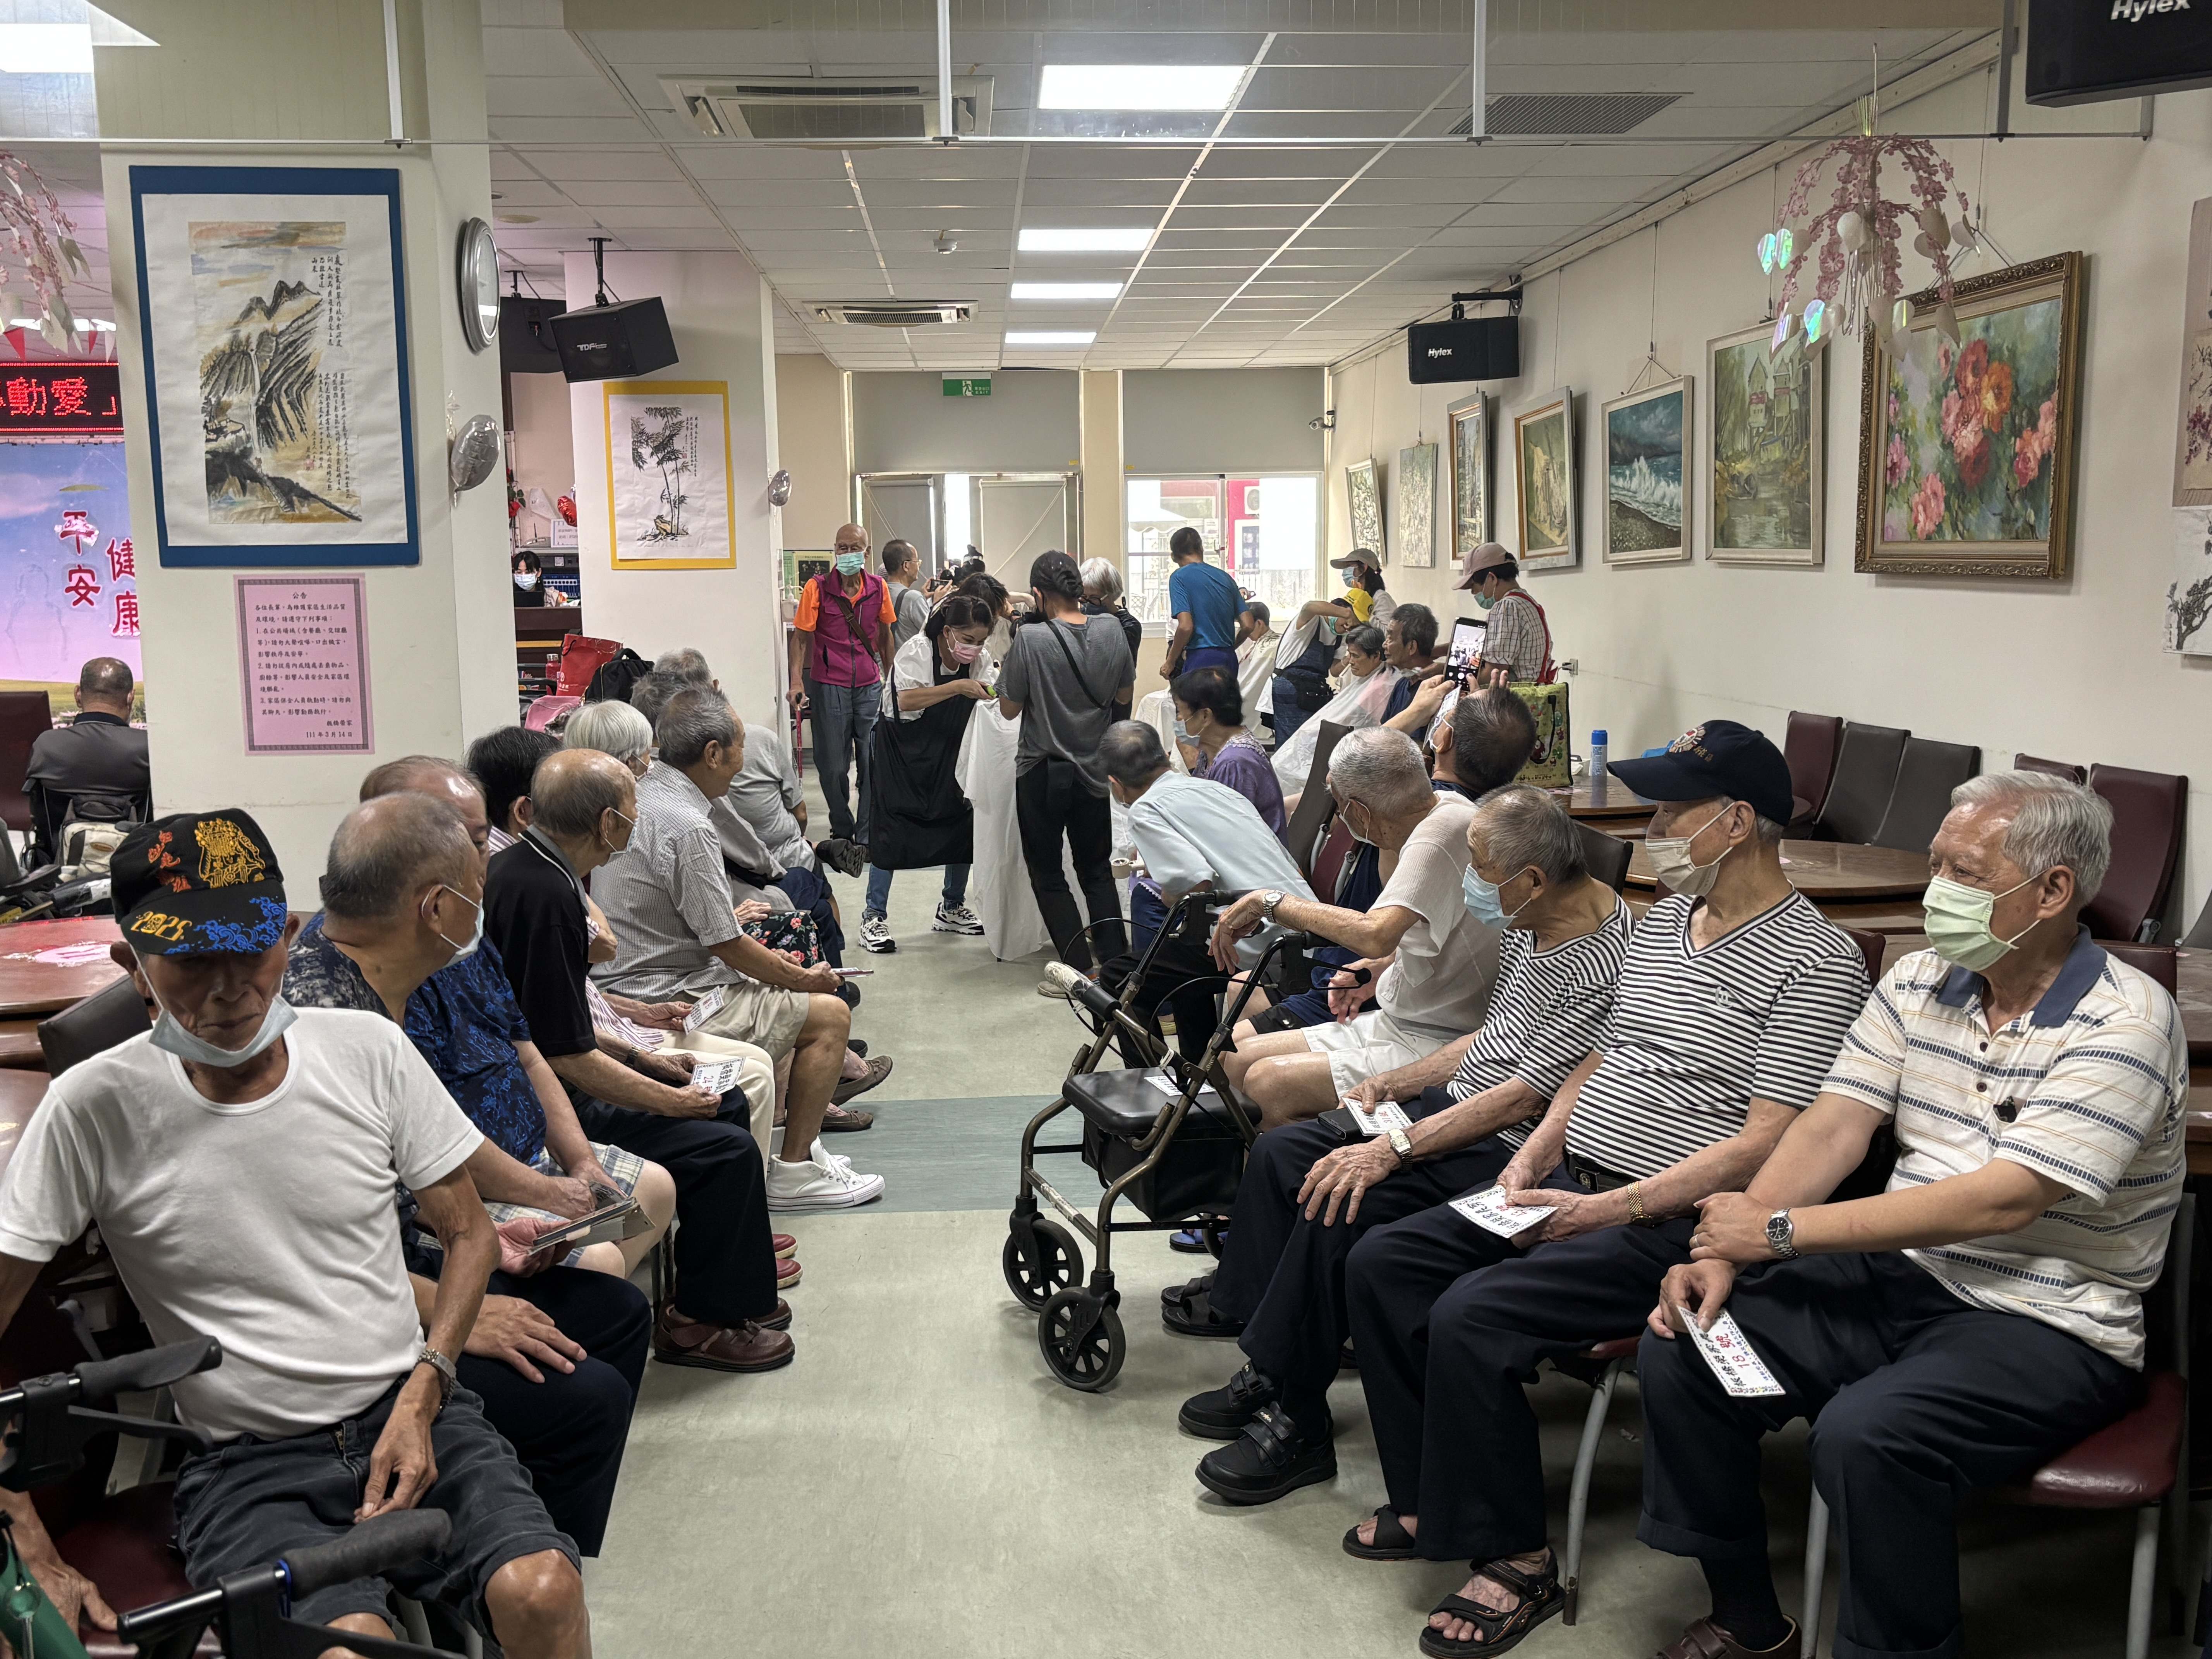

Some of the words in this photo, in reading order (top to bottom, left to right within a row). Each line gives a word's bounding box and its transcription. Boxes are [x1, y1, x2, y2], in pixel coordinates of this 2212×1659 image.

[2111, 0, 2191, 22] Hylex
[1428, 347, 1452, 358] Hylex
[0, 376, 117, 417] 動愛」
[59, 510, 101, 607] 平安
